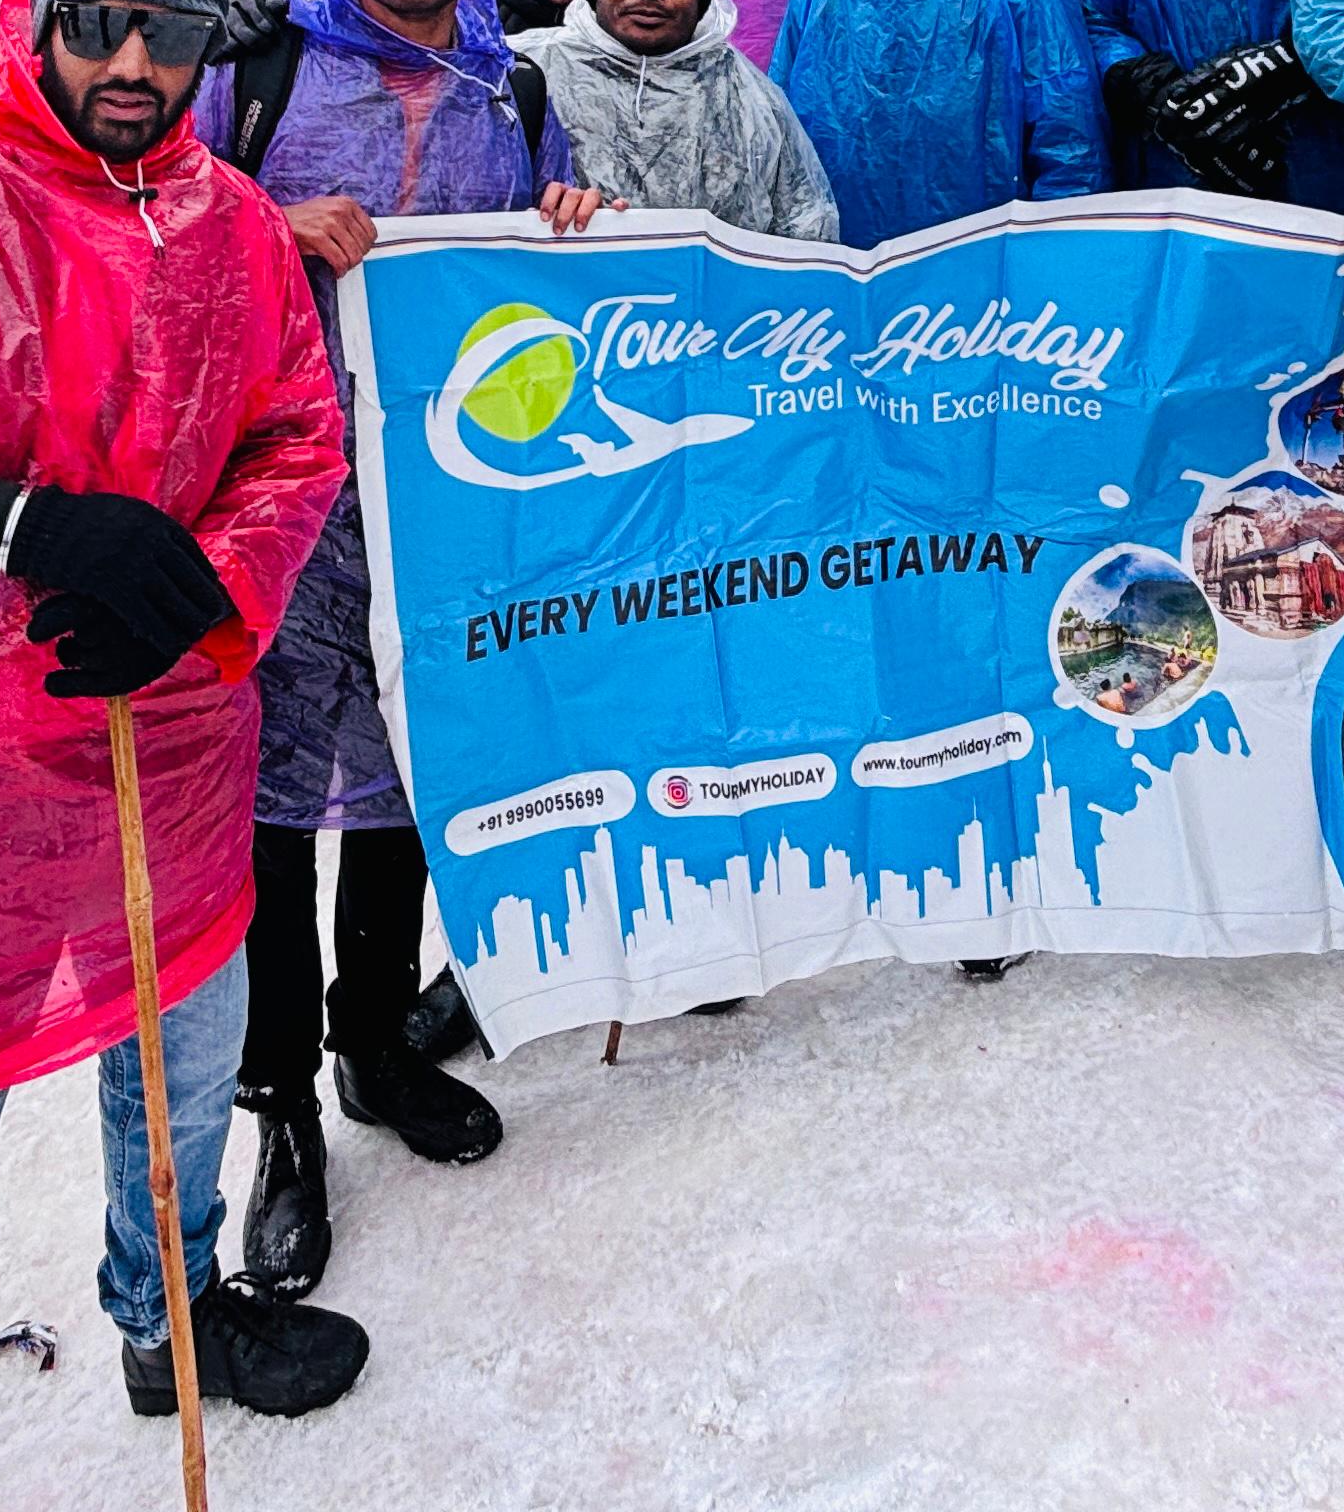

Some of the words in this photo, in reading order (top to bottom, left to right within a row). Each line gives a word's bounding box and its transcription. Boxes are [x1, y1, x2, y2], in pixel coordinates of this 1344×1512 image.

[581, 293, 719, 381] Tour
[723, 307, 847, 383] My
[850, 297, 1125, 391] Holiday
[748, 377, 844, 417] Travel
[855, 384, 919, 425] with
[932, 383, 1103, 424] Excellence
[465, 587, 601, 664] EVERY
[611, 550, 810, 627] WEEKEND
[820, 531, 1046, 591] GETAWAY
[862, 730, 1023, 772] www.tourmyholiday.com
[699, 767, 826, 800] TOURMYHOLIDAY
[477, 813, 503, 832] +91
[505, 786, 605, 826] 9990055699
